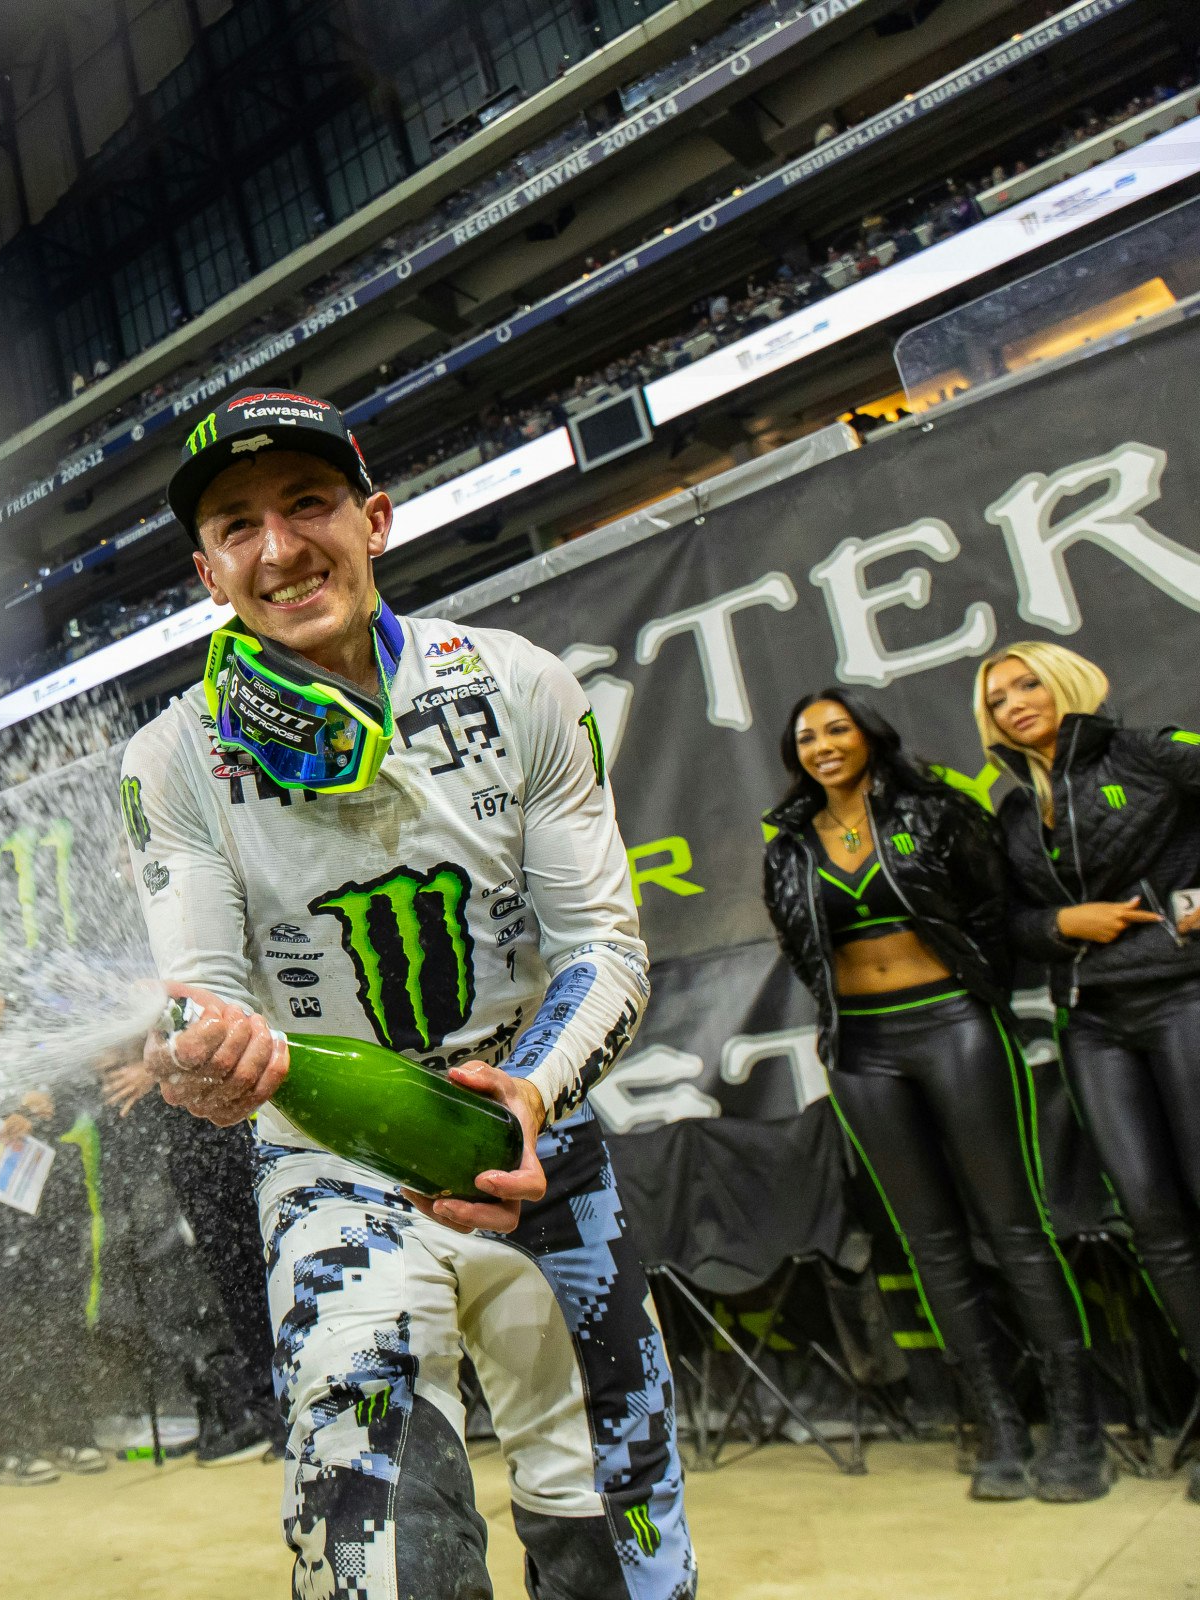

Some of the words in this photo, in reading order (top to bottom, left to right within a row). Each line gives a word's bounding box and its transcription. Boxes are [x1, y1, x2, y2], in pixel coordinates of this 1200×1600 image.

[919, 24, 1063, 111] QUARTERBACK
[452, 197, 522, 246] REGGIE
[522, 151, 593, 201] WAYNE
[600, 98, 679, 156] 2001-14
[172, 373, 227, 417] PEYTON
[227, 333, 297, 383] MANNING
[301, 296, 359, 340] 1998-11
[227, 393, 266, 412] PRO
[265, 391, 331, 410] CIRCUIT
[243, 406, 324, 422] Kawasaki
[6, 477, 56, 518] FREENEY
[207, 642, 220, 680] SCOTT
[425, 636, 476, 658] AMA
[239, 685, 314, 730] SCOTT
[253, 681, 277, 700] 2025
[414, 676, 500, 714] Kawasak
[239, 702, 303, 743] SUPERCROSS
[264, 950, 325, 961] DUNLOP
[290, 997, 321, 1015] PPG
